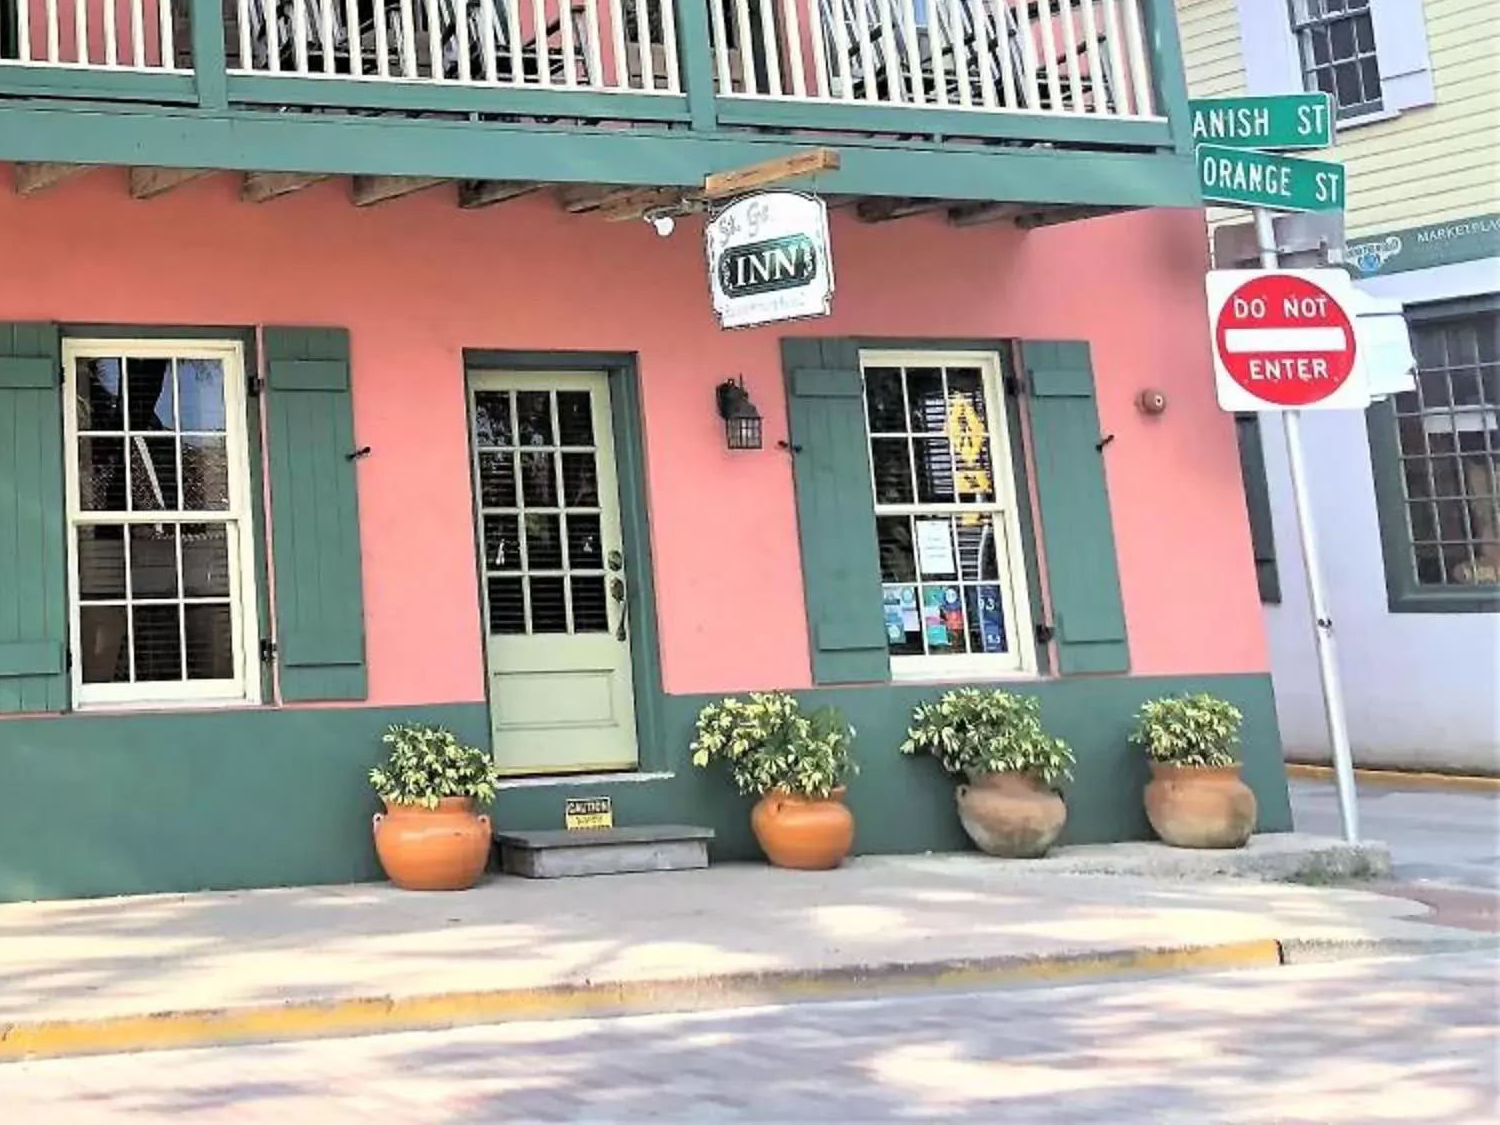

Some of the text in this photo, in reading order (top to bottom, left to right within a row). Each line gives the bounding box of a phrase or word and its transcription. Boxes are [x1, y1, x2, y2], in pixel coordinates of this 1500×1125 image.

[1297, 104, 1325, 135] ST
[1202, 156, 1340, 204] ORANGE ST
[735, 246, 798, 287] INN
[1234, 297, 1329, 319] DO NOT
[1248, 357, 1330, 381] ENTER
